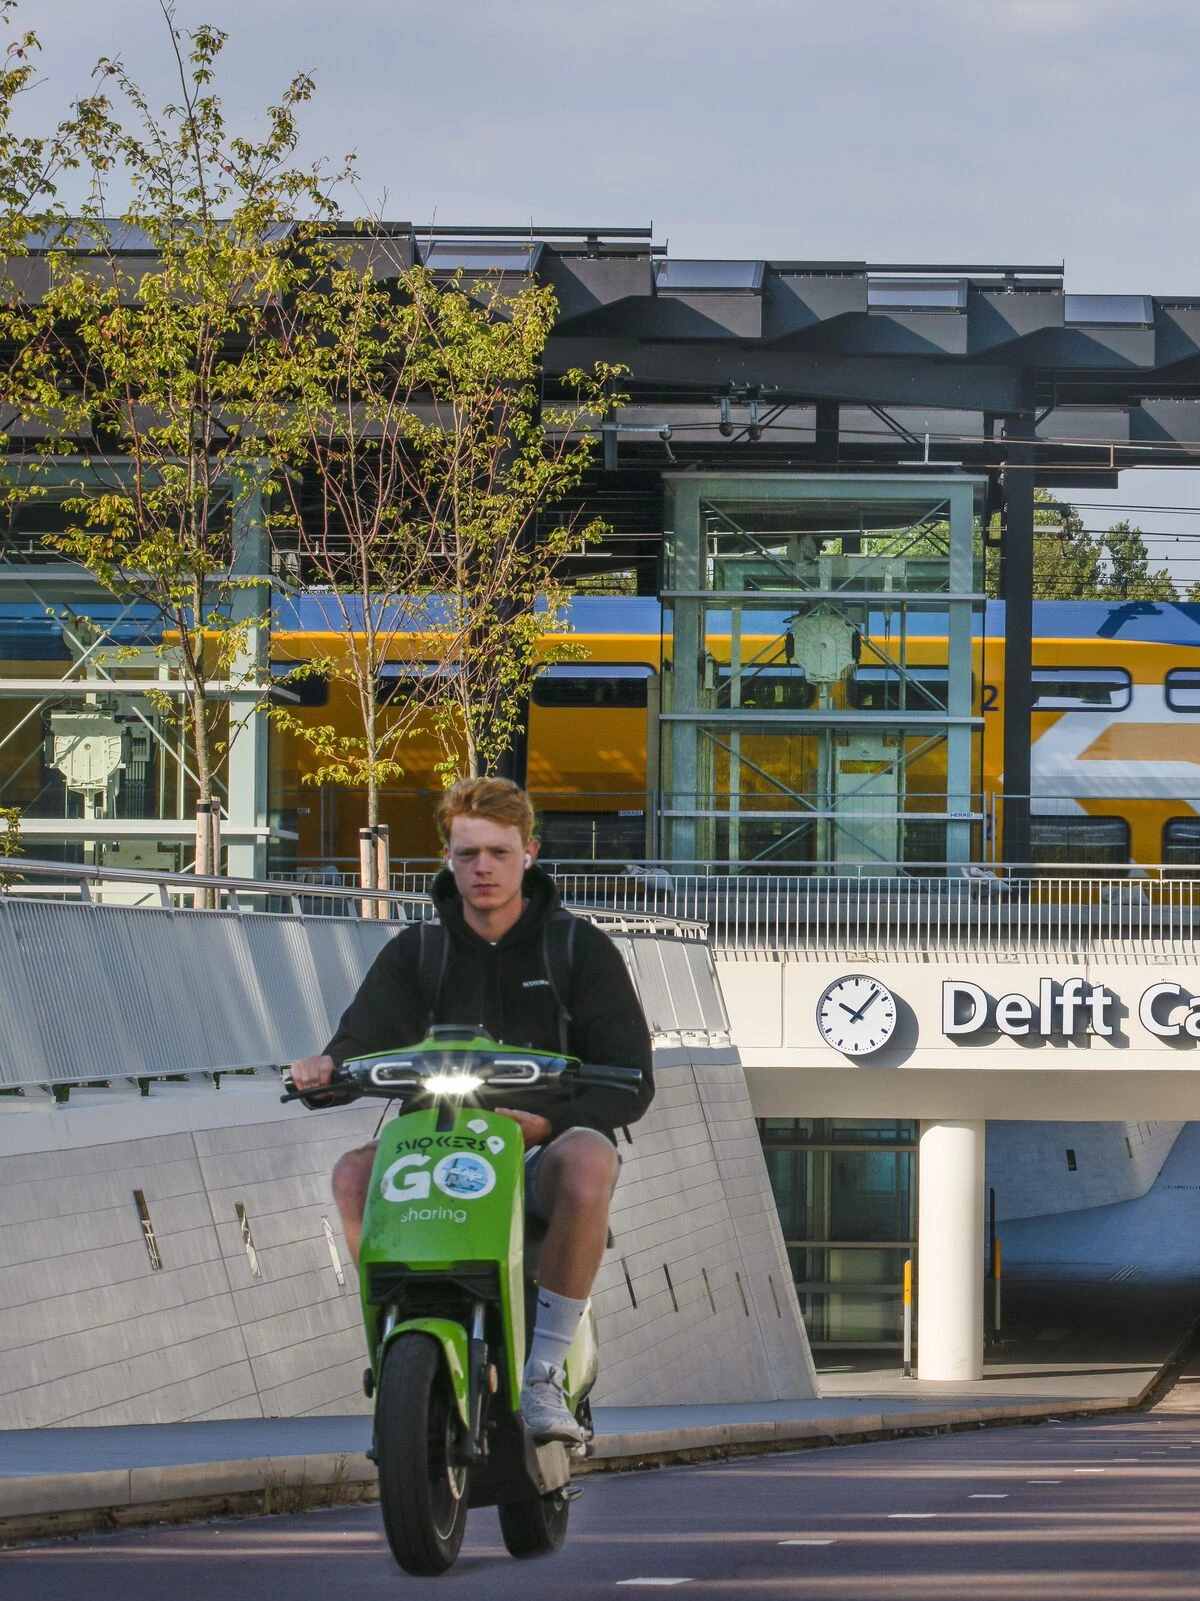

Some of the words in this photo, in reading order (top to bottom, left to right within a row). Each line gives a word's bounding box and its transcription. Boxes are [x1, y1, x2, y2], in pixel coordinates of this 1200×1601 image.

[981, 684, 999, 711] 2
[942, 977, 1113, 1036] Delft
[381, 1152, 497, 1203] GO
[400, 1207, 467, 1223] sharing
